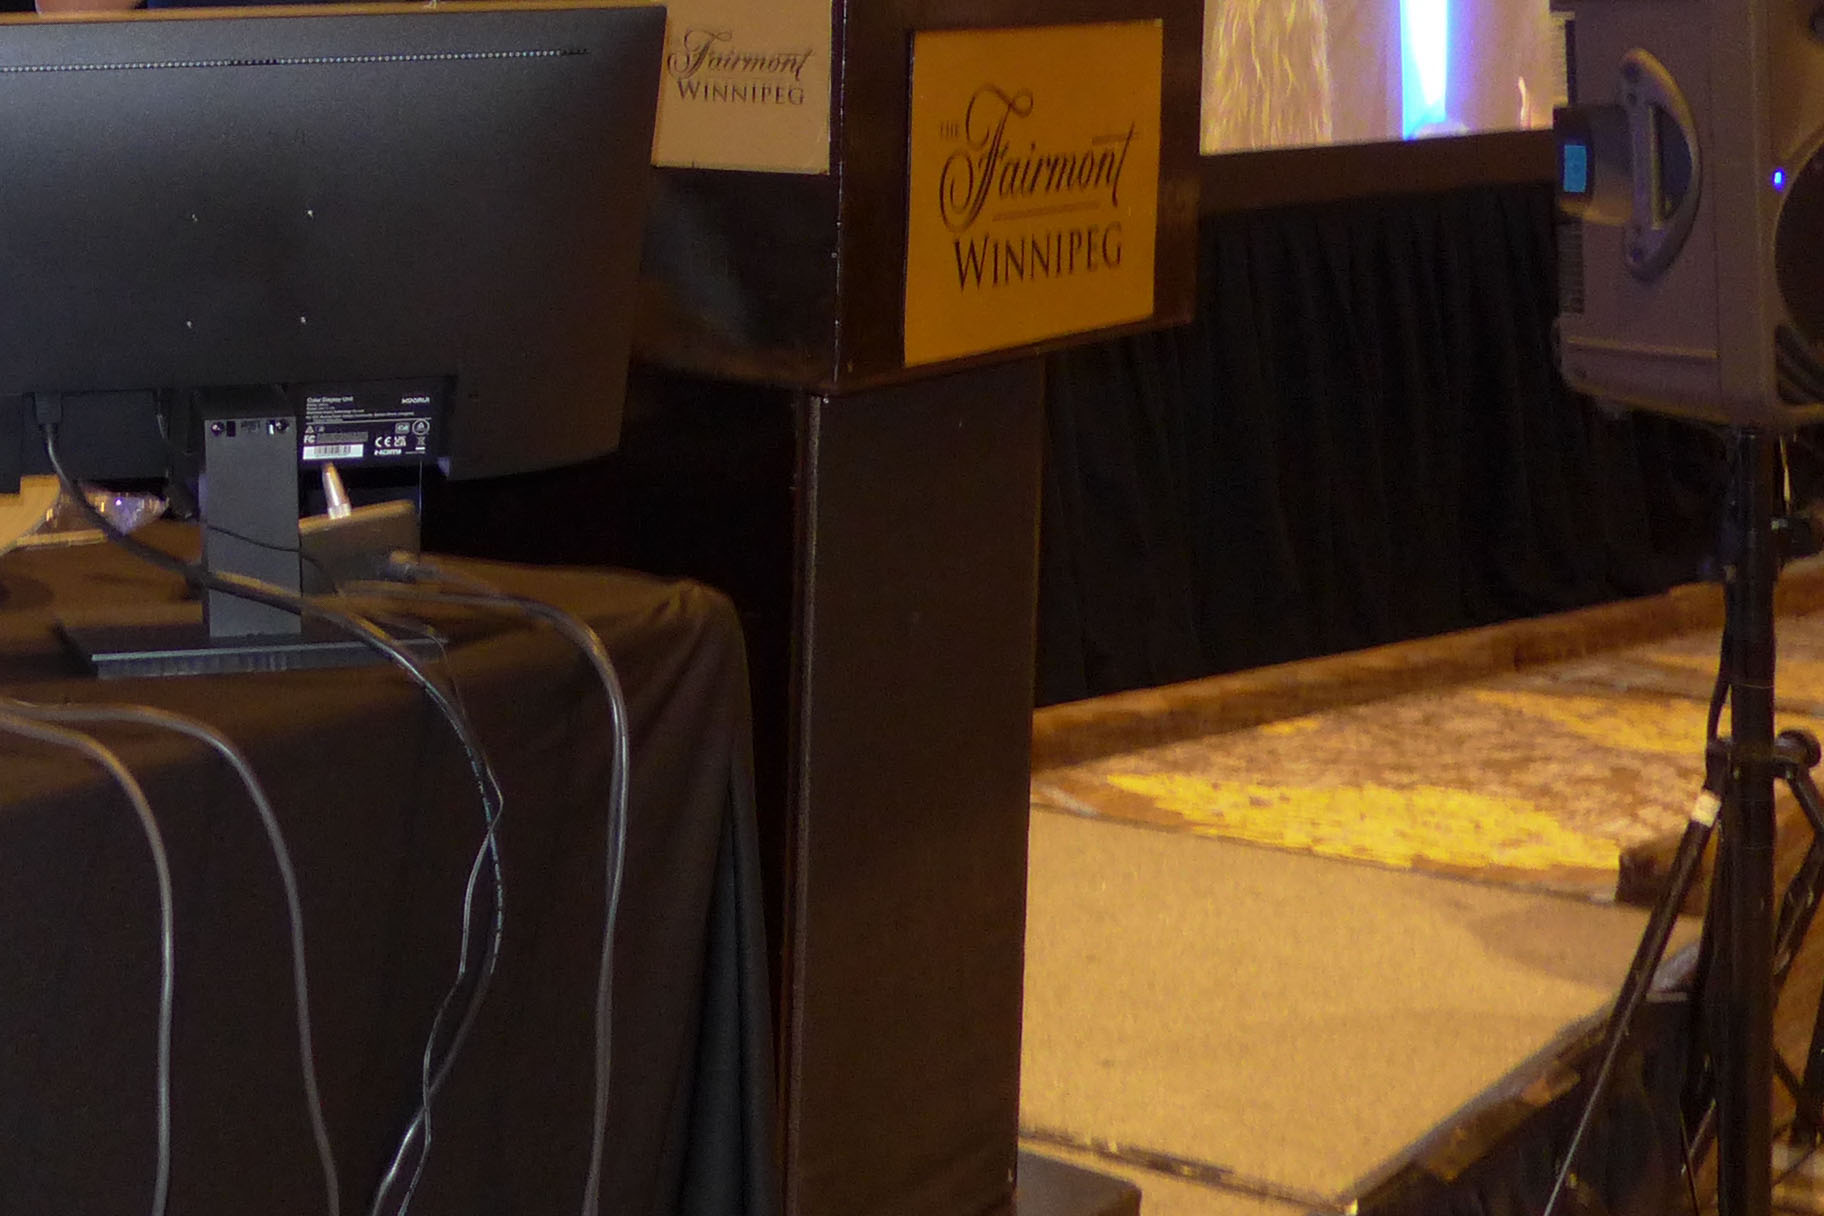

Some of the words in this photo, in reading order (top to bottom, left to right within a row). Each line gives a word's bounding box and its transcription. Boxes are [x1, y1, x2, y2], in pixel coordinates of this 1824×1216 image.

[667, 27, 815, 82] Fairmont
[677, 79, 805, 105] WINNIPEG
[939, 83, 1138, 233] Fairmont
[954, 221, 1123, 291] WINNIPEG
